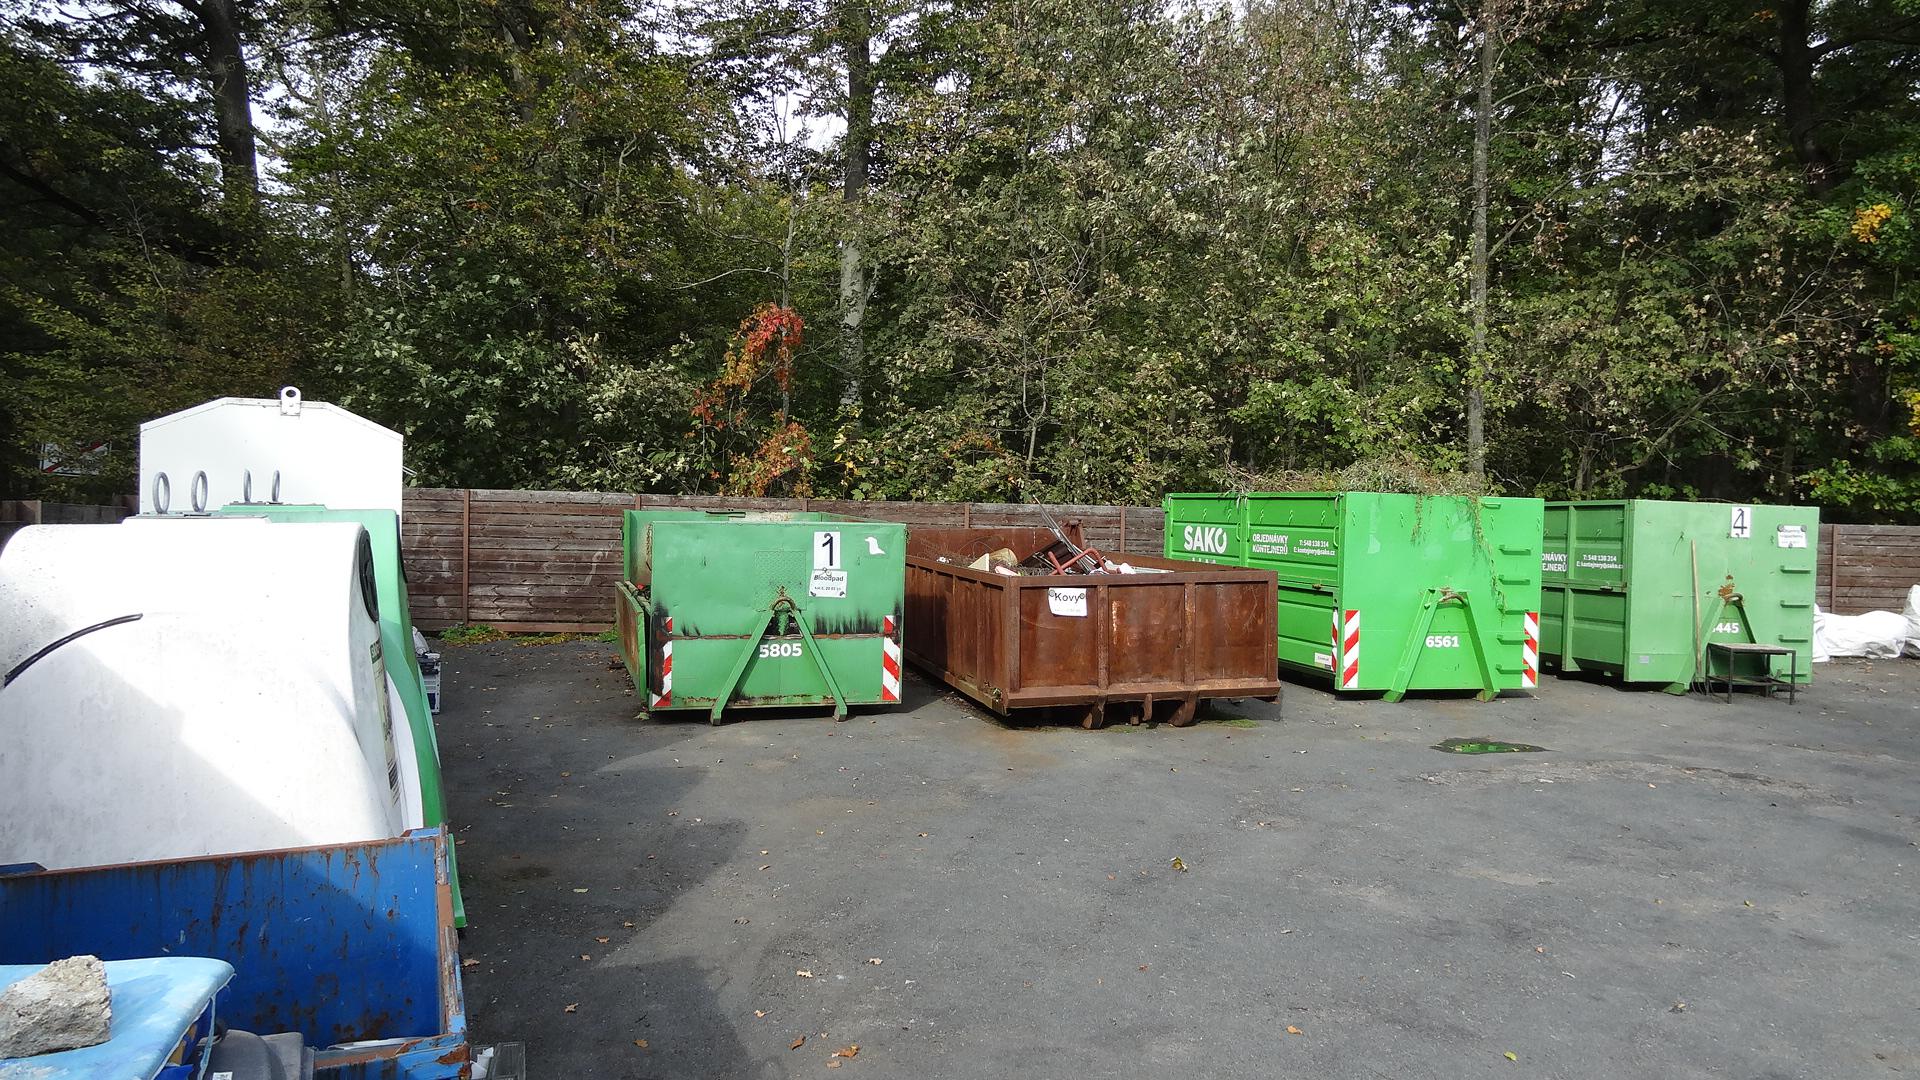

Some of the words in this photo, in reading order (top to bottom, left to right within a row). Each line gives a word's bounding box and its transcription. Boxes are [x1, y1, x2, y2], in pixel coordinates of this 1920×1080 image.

[1733, 510, 1748, 535] 4
[1184, 525, 1227, 554] SAKO
[1252, 533, 1289, 544] OBJEDNÁVKY
[822, 535, 834, 567] 1
[1252, 544, 1288, 555] KONTEJNERŮ
[1055, 593, 1081, 604] Kovy
[1712, 622, 1739, 634] 445
[1425, 635, 1460, 648] 6561
[759, 643, 802, 658] 5805
